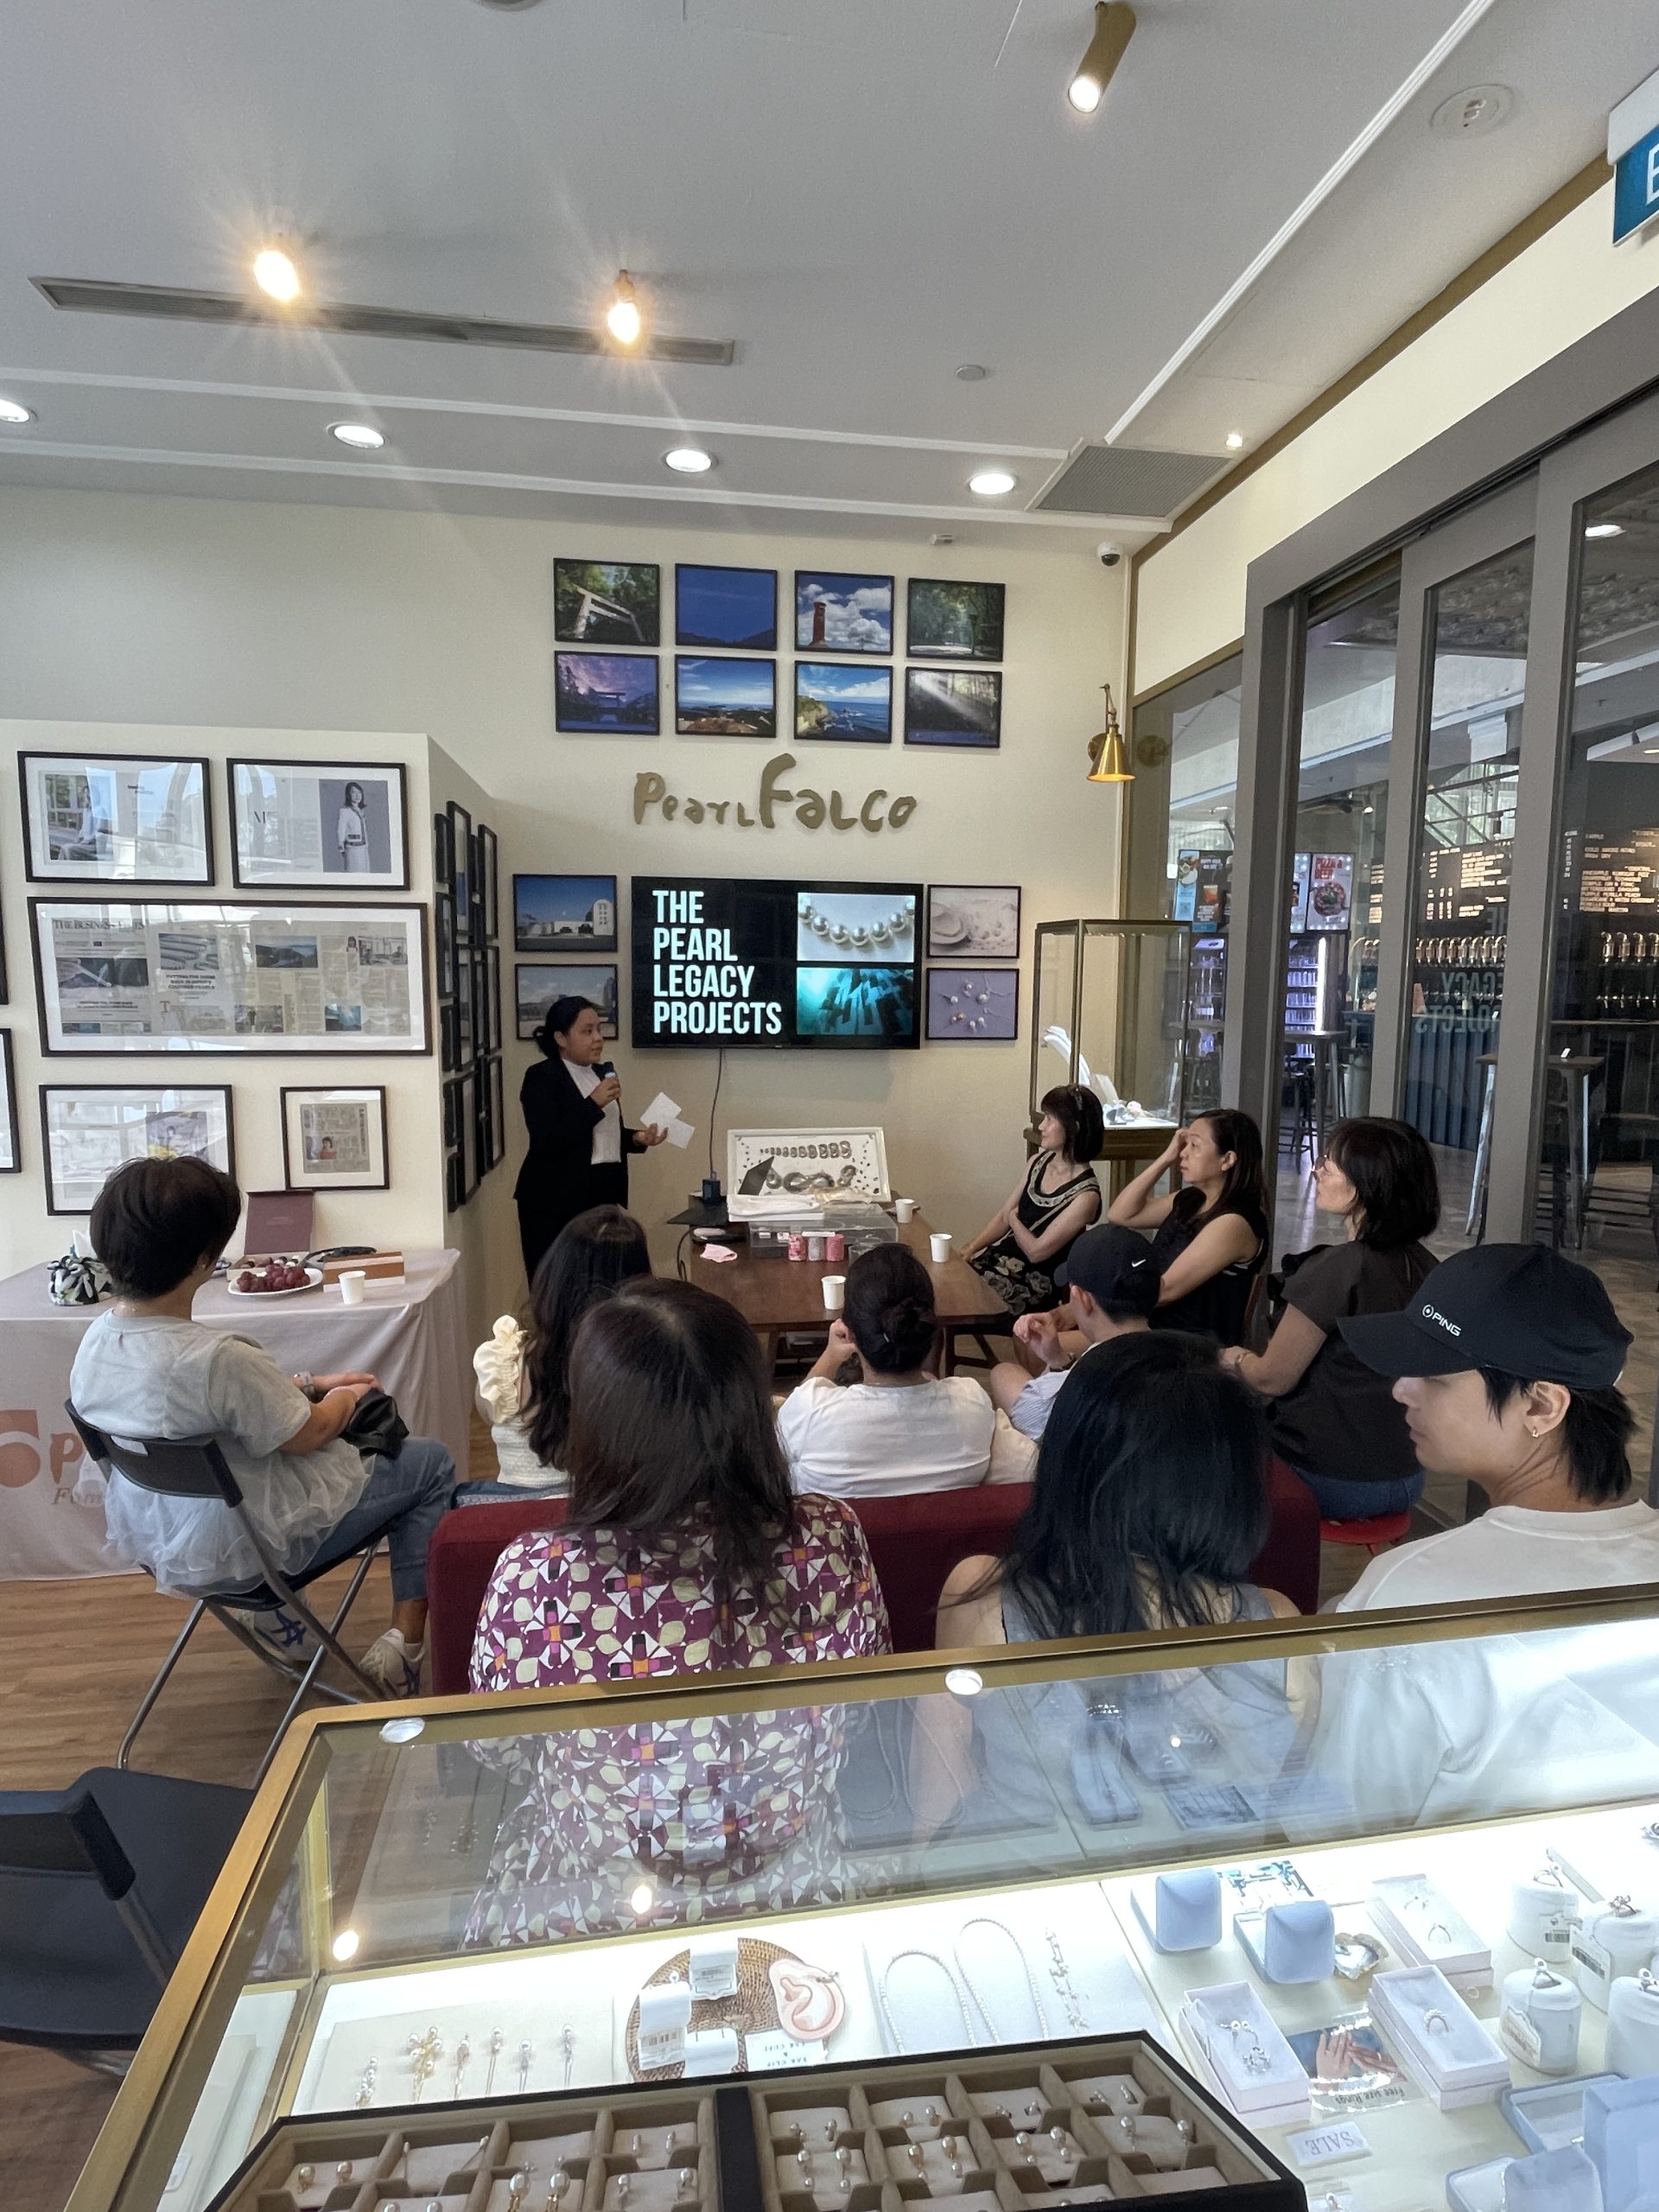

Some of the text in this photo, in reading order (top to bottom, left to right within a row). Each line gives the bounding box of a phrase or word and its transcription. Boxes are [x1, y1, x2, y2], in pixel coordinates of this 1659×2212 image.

[652, 890, 704, 924] THE
[653, 927, 738, 962] PEARL
[653, 964, 755, 998] LEGACY
[653, 1001, 782, 1035] PROJECTS
[1432, 1312, 1462, 1337] PING
[1335, 2087, 1405, 2105] Free size Rings
[1305, 2131, 1355, 2156] SALE
